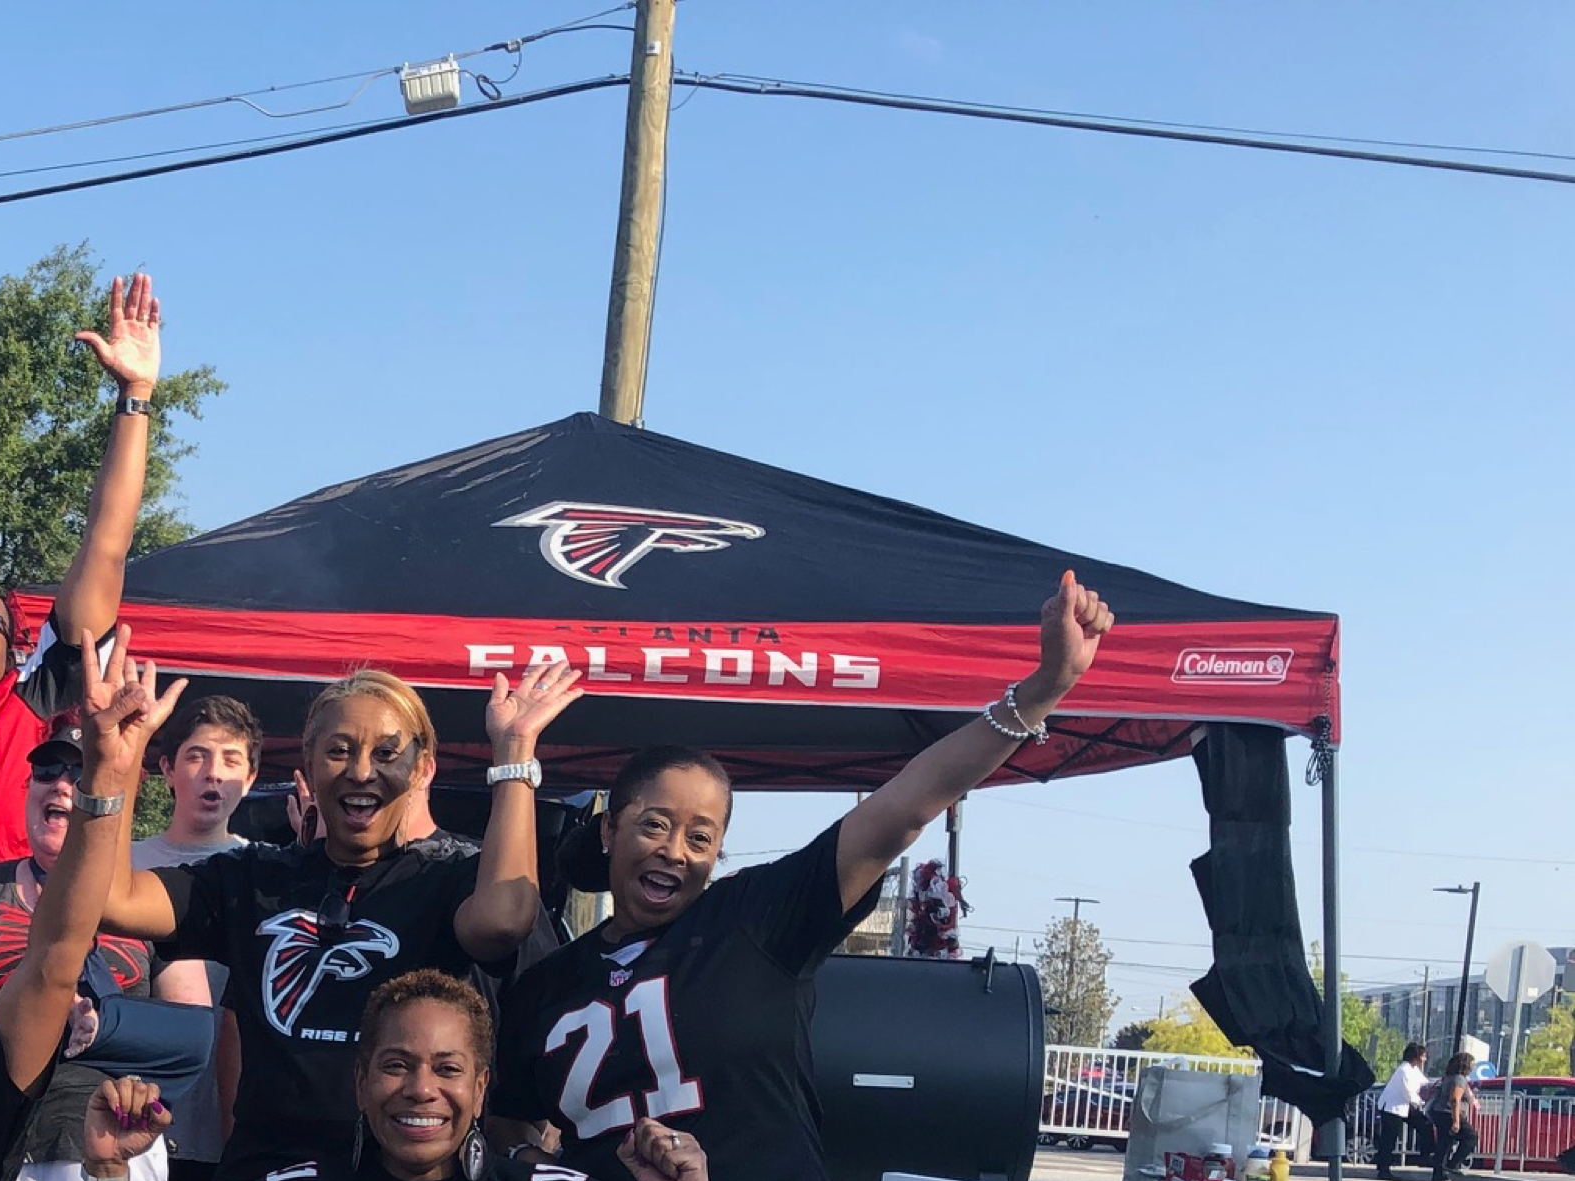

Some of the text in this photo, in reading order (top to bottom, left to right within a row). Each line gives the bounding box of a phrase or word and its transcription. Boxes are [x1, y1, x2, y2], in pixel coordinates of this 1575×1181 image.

[1183, 652, 1265, 675] Coleman
[300, 1027, 348, 1042] RISE
[544, 975, 704, 1139] 21
